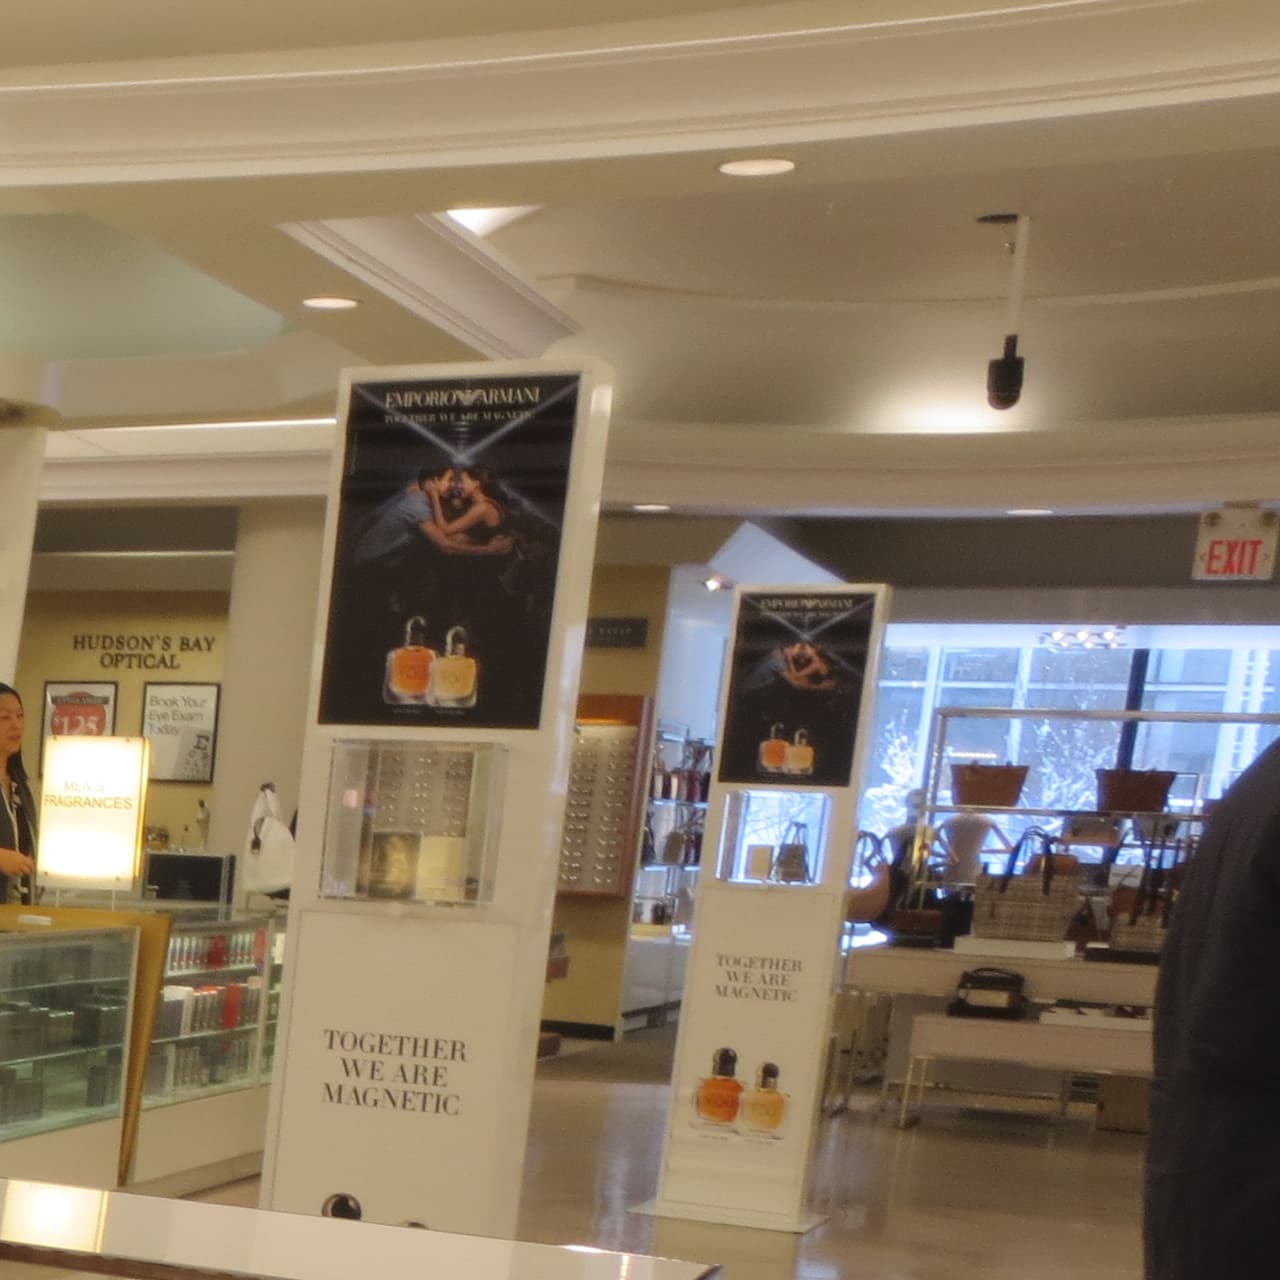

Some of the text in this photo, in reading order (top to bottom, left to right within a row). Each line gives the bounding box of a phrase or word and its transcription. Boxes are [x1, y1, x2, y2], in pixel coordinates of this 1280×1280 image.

[385, 386, 540, 409] EMPORIO ARMANI
[1206, 539, 1264, 575] EXIT
[73, 634, 216, 652] HUDSON'S BAY
[100, 653, 180, 670] OPTICAL
[150, 696, 208, 708] Book Your
[172, 710, 204, 721] Exam
[44, 794, 132, 810] FRAGRANCES
[715, 954, 802, 972] TOGETHER
[726, 971, 790, 986] WE ARE
[323, 1029, 467, 1063] TOGETHER
[340, 1057, 448, 1088] WE ARE
[320, 1082, 461, 1116] MAGNETIC
